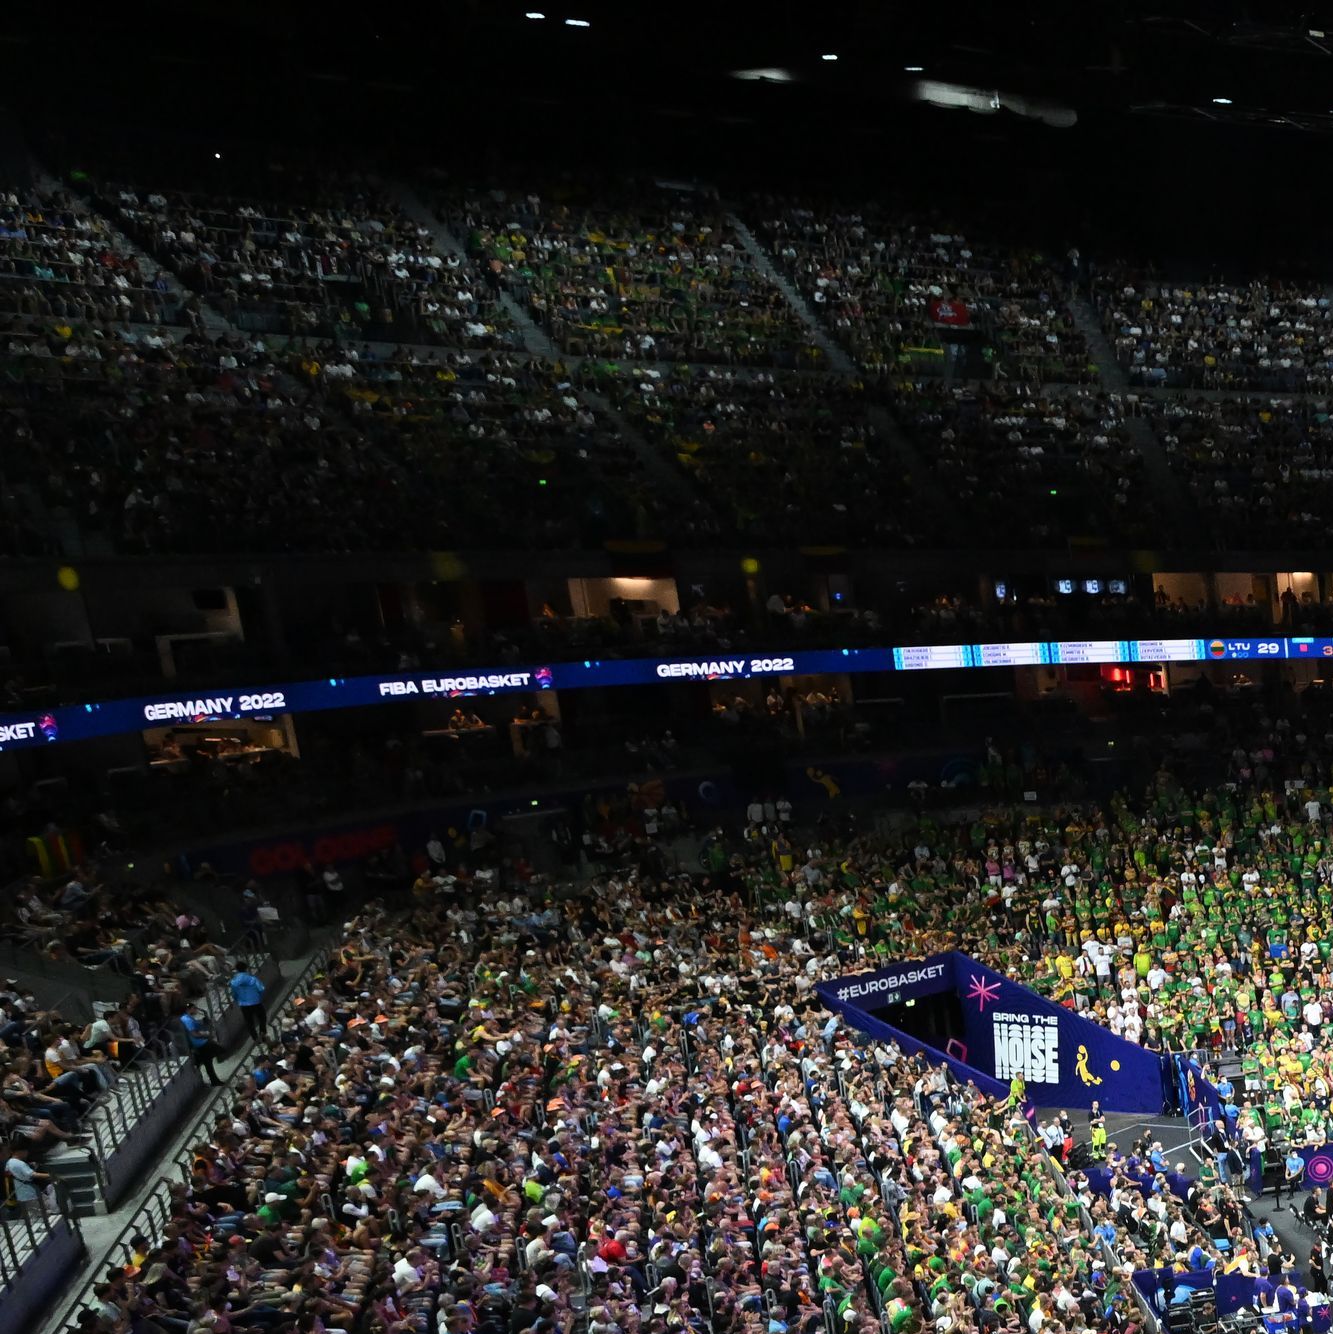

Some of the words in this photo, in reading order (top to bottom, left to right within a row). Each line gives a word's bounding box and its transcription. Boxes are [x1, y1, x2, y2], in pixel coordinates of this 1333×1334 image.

[1228, 643, 1250, 651] LTU
[1257, 643, 1279, 654] 29
[657, 661, 747, 679] GERMANY
[748, 658, 794, 676] 2022
[379, 681, 418, 695] FIBA
[422, 673, 530, 695] EUROBASKET
[144, 697, 237, 722] GERMANY
[239, 693, 285, 710] 2022
[837, 963, 945, 1001] #EUROBASKET
[992, 1010, 1030, 1025] BRING
[1033, 1014, 1058, 1026] THE
[994, 1028, 1059, 1078] NOISE
